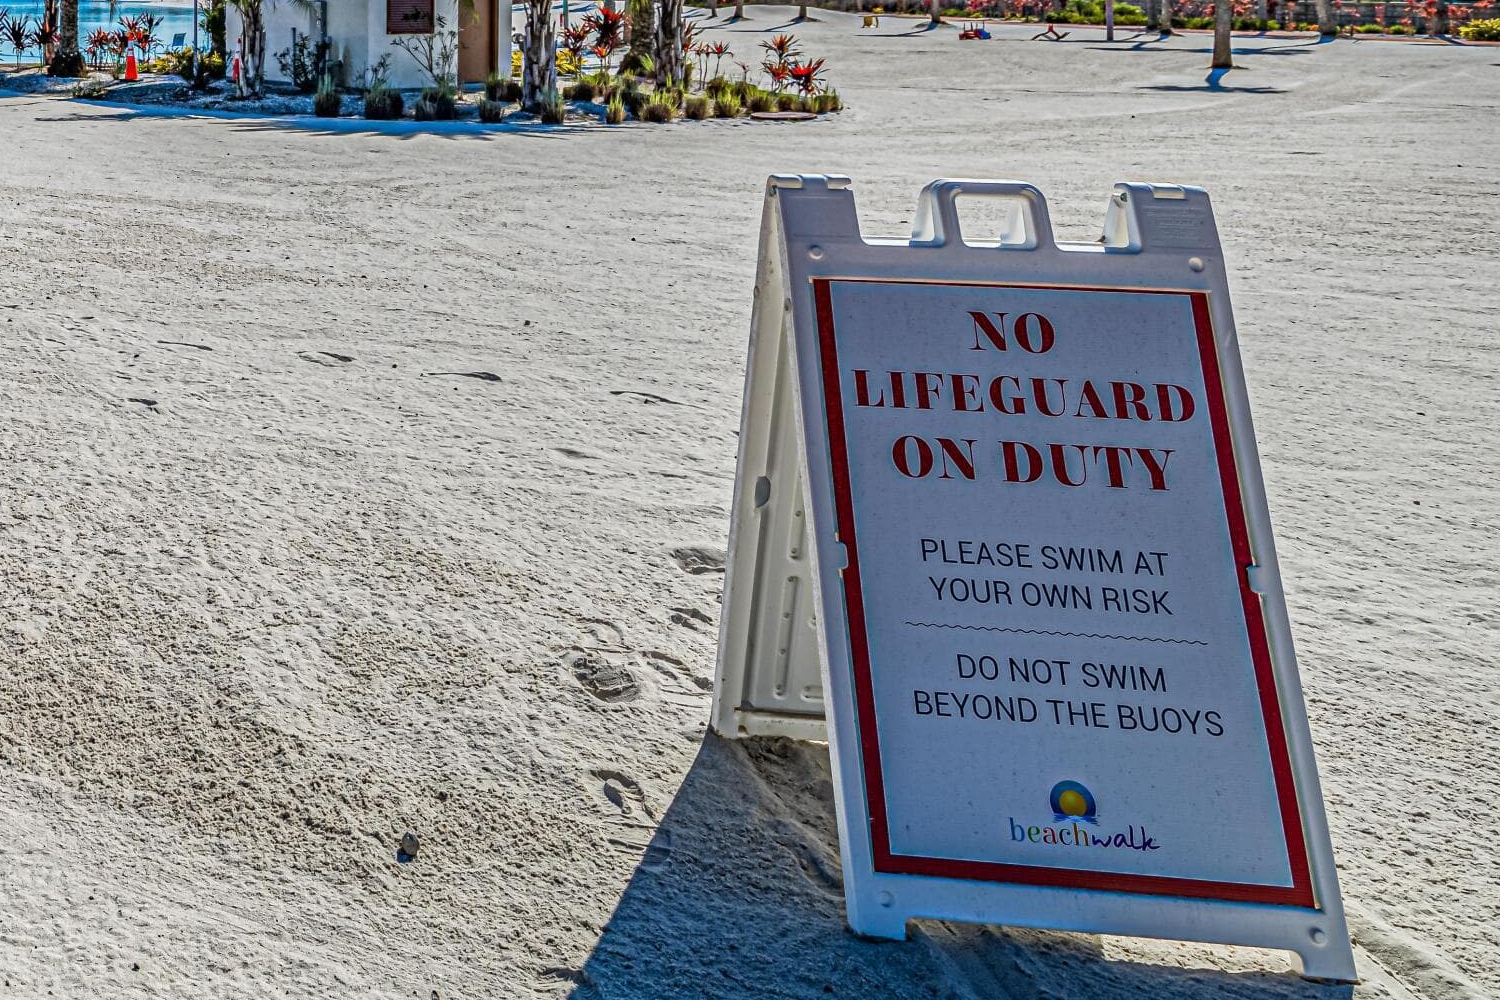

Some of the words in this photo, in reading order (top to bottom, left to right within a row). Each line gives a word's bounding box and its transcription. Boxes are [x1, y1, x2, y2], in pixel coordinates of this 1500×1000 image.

[966, 310, 1056, 354] NO
[851, 369, 1196, 422] LIFEGUARD
[891, 435, 978, 480] ON
[998, 440, 1177, 491] DUTY
[920, 538, 1033, 568] PLEASE
[1041, 546, 1124, 574] SWIM
[1134, 551, 1168, 576] AT
[929, 576, 1012, 605] YOUR
[1021, 582, 1092, 610] OWN
[1102, 587, 1173, 615] RISK
[956, 653, 999, 681] DO
[1008, 657, 1070, 686] NOT
[1082, 662, 1167, 693] SWIM
[913, 690, 1038, 723] BEYOND
[1045, 699, 1110, 729] THE
[1117, 704, 1225, 737] BUOYS
[1009, 817, 1161, 851] beachwalk
